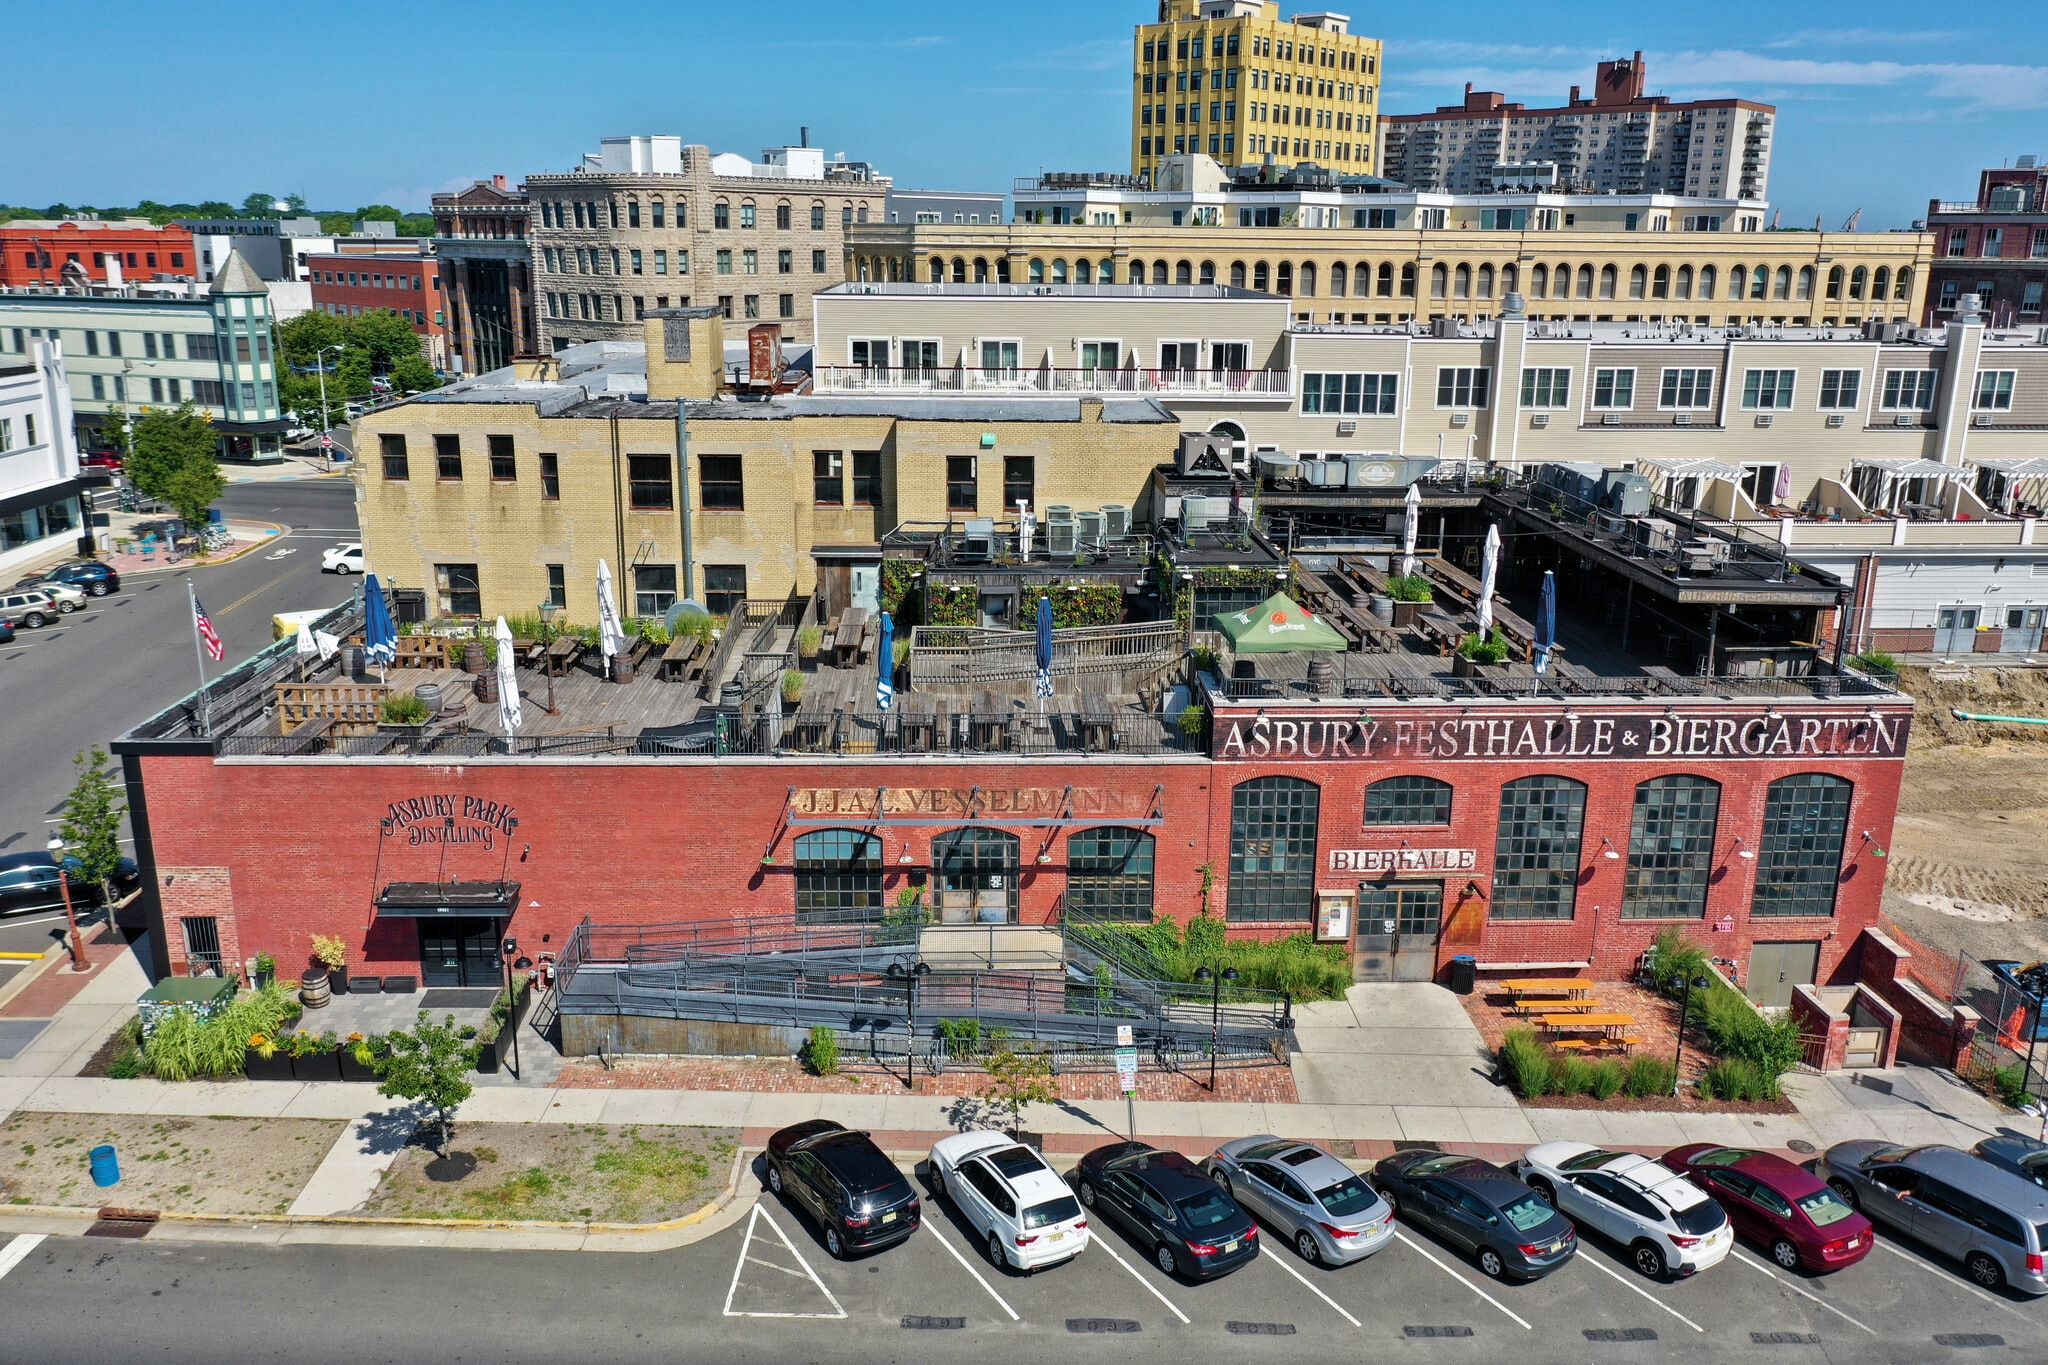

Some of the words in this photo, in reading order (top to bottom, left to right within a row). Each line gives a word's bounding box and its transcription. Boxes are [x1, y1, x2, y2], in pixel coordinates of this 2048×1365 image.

[1219, 720, 1379, 759] ASBURY
[1393, 718, 1616, 757] FESTHALLE
[1622, 730, 1640, 746] &
[1647, 717, 1905, 757] BIERGARTEN
[384, 794, 457, 837] ASBURY
[463, 795, 516, 837] PARK
[408, 825, 495, 851] DISTILLING
[1333, 850, 1474, 870] BIERHALLE
[1069, 1319, 1137, 1333] 5092
